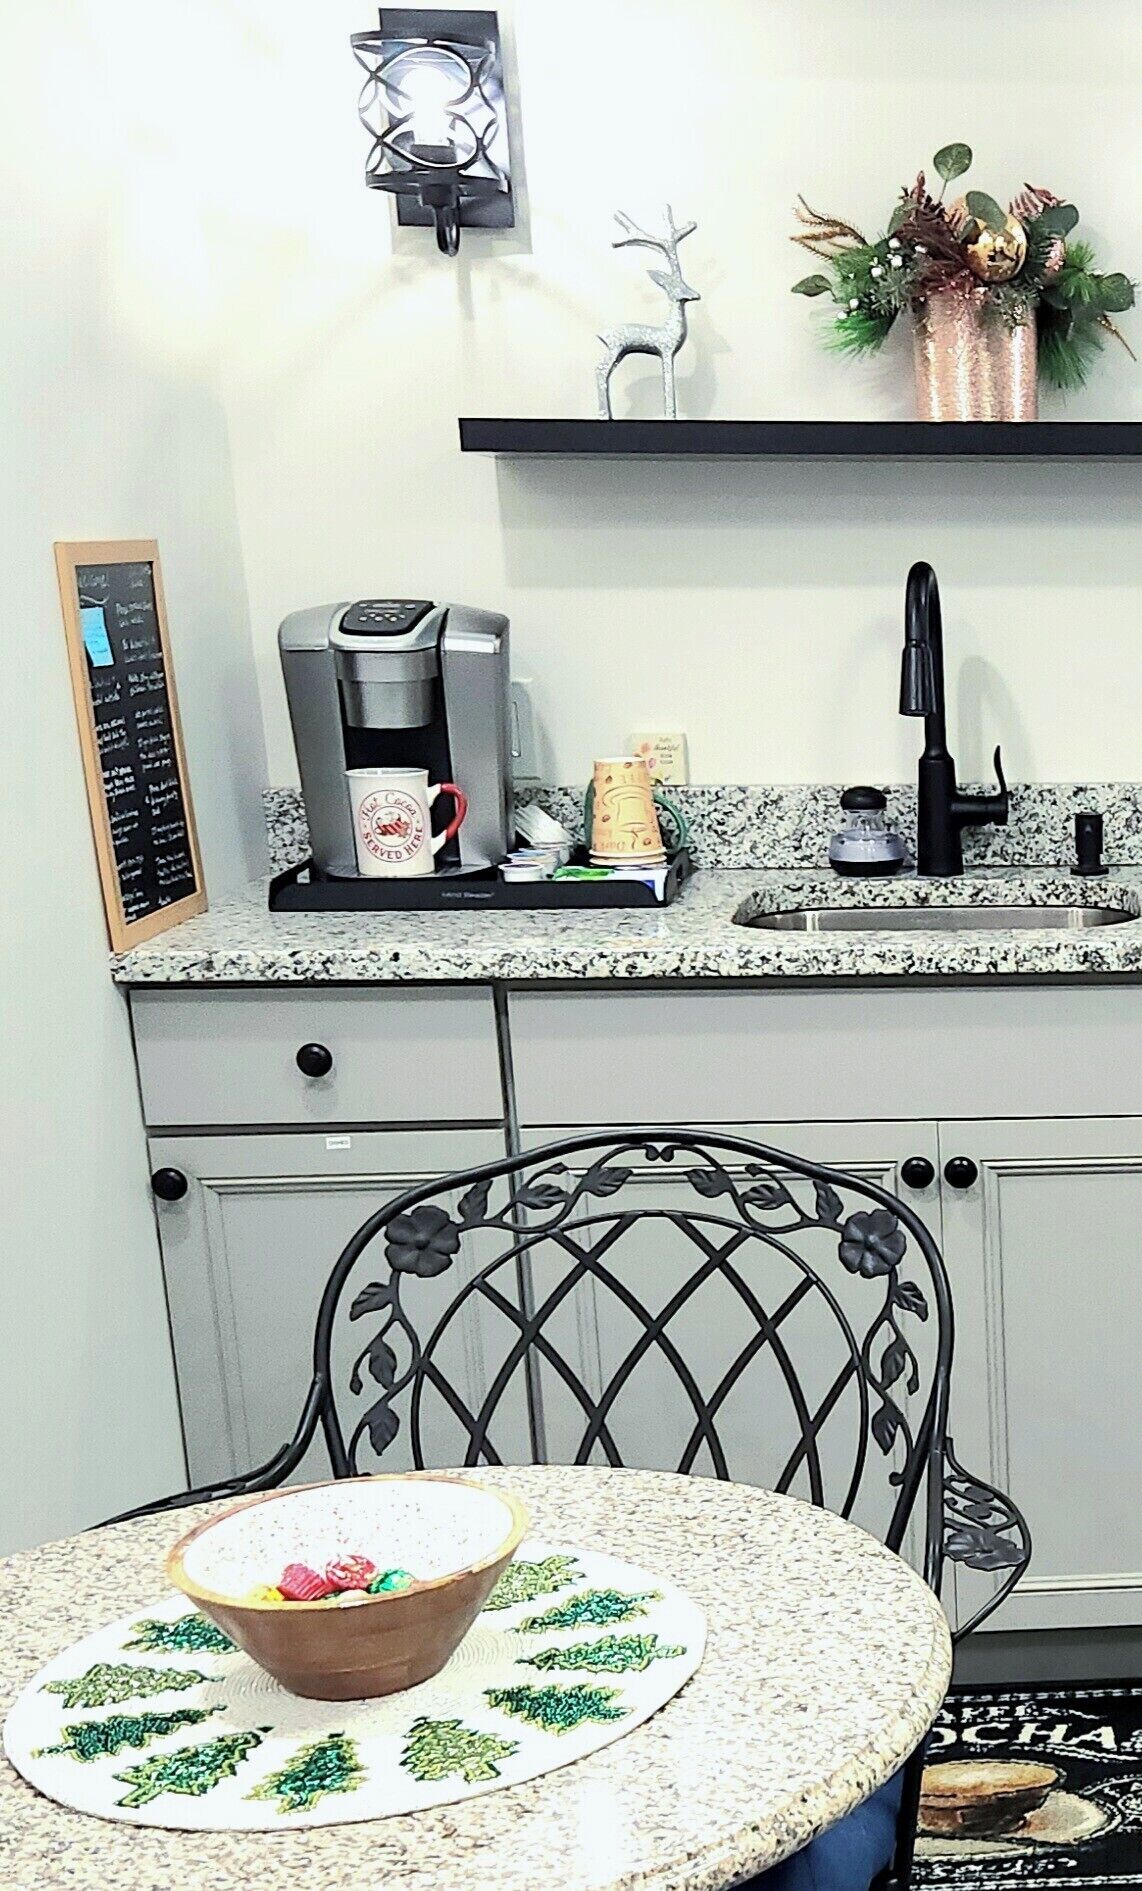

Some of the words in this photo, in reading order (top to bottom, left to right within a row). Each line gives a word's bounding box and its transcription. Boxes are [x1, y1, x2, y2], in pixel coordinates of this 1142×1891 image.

[385, 792, 417, 818] Cocoa
[363, 832, 402, 860] SERVED
[404, 827, 423, 856] HERE
[930, 1722, 1118, 1751] OCHA
